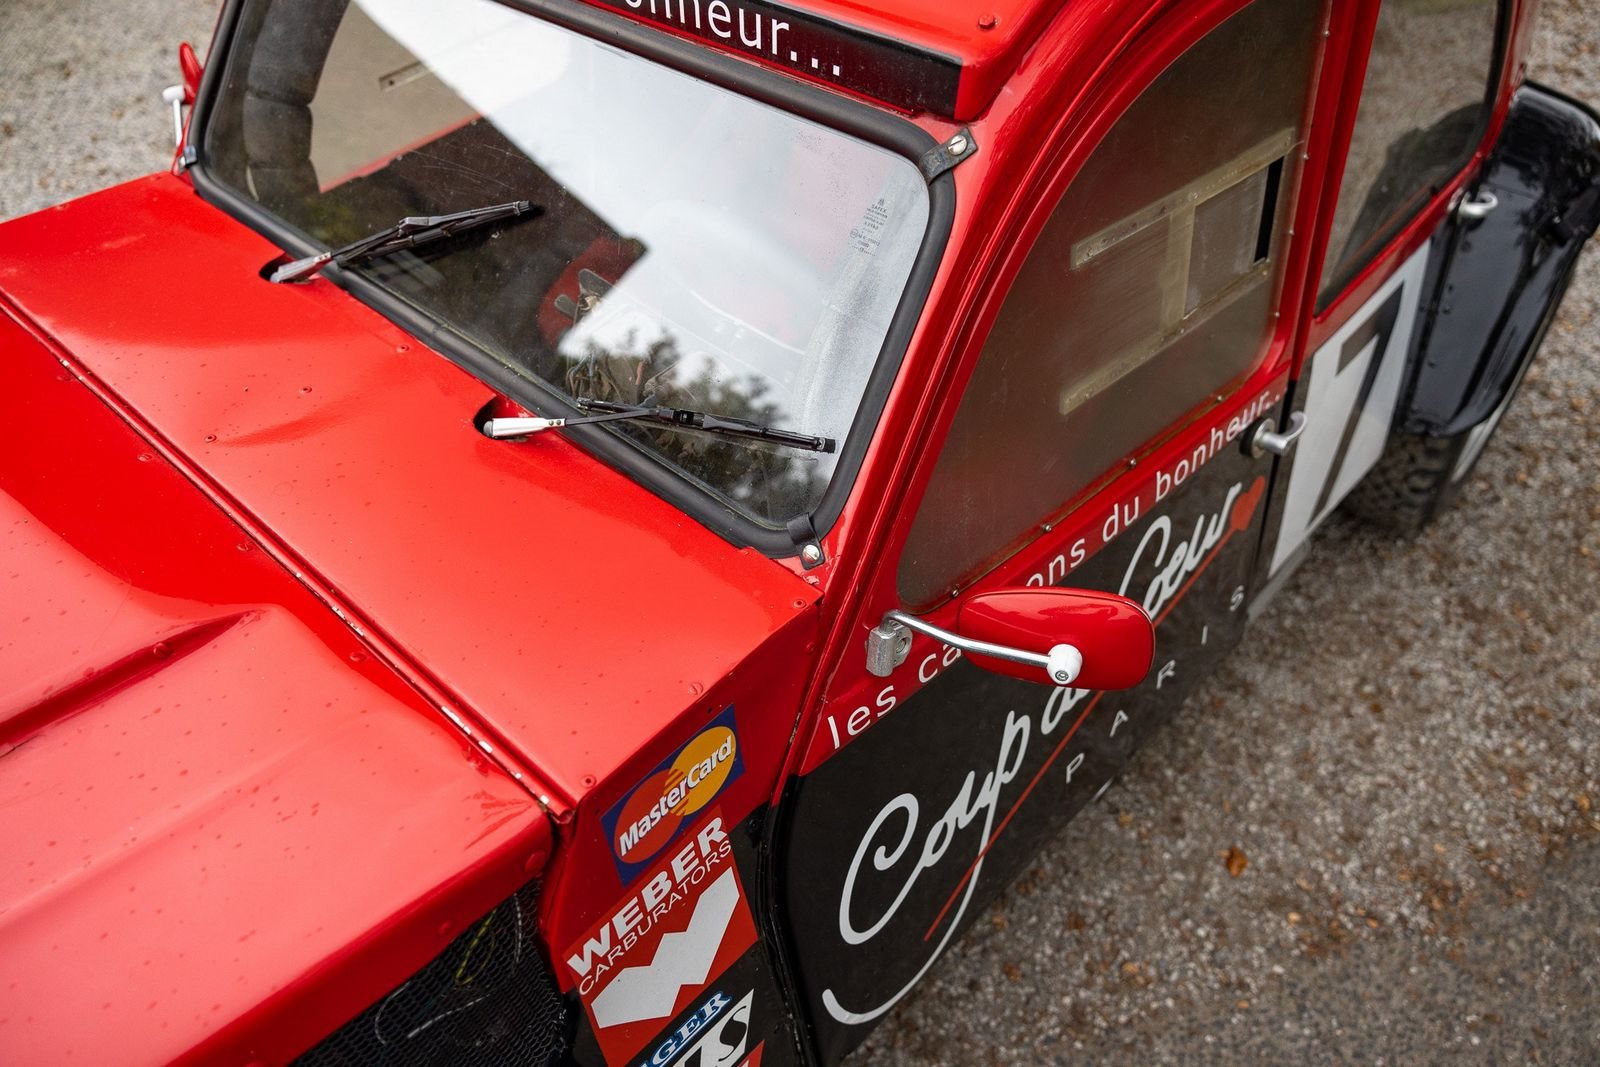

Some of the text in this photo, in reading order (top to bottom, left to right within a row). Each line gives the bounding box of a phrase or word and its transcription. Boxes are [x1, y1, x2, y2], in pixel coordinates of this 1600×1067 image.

[828, 685, 897, 750] les
[1102, 495, 1139, 542] du
[619, 735, 732, 857] MasterCard
[566, 816, 728, 978] WEBER
[578, 840, 732, 996] CARBURATORS
[639, 992, 732, 1067] GER
